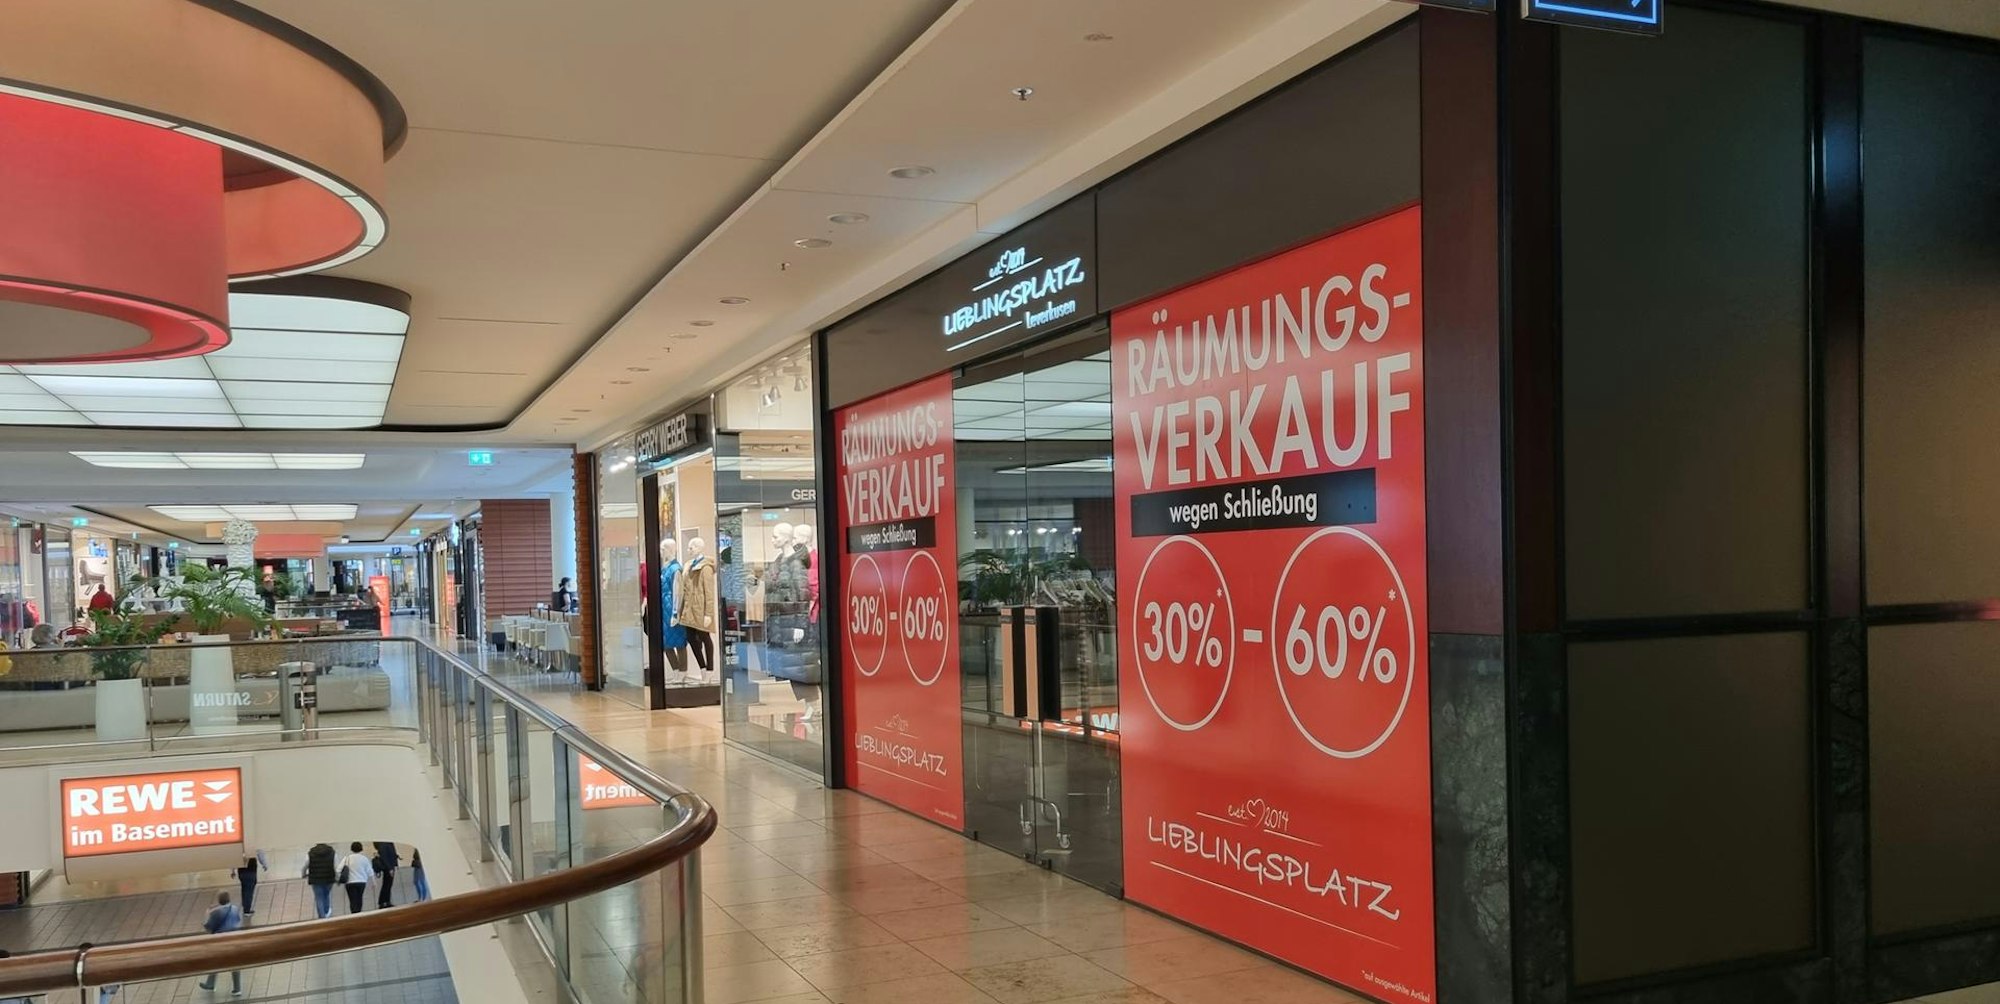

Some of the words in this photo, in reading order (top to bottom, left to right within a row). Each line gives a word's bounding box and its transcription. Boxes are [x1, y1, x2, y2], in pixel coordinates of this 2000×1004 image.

[944, 257, 1085, 336] LIEBLINGSPLATZ
[1025, 300, 1076, 329] Leverkusen
[1128, 264, 1411, 398] RÄUMUNGS-
[637, 426, 658, 462] GERRY
[659, 413, 688, 454] WEBER
[841, 401, 943, 466] RÄUMUNGS-
[1130, 352, 1411, 490] VERKAUF
[843, 453, 945, 525] VERKAUF
[1169, 501, 1219, 529] wegen
[1224, 484, 1318, 521] Schließung
[861, 533, 880, 549] wegen
[882, 523, 917, 546] Schließung
[855, 732, 947, 777] LIEBLINGSPLATZ
[69, 780, 198, 818] REWE
[1264, 806, 1289, 832] 2014
[71, 825, 103, 846] im
[111, 815, 236, 843] Basement
[1148, 816, 1401, 921] LIEBLINGSPLATZ
